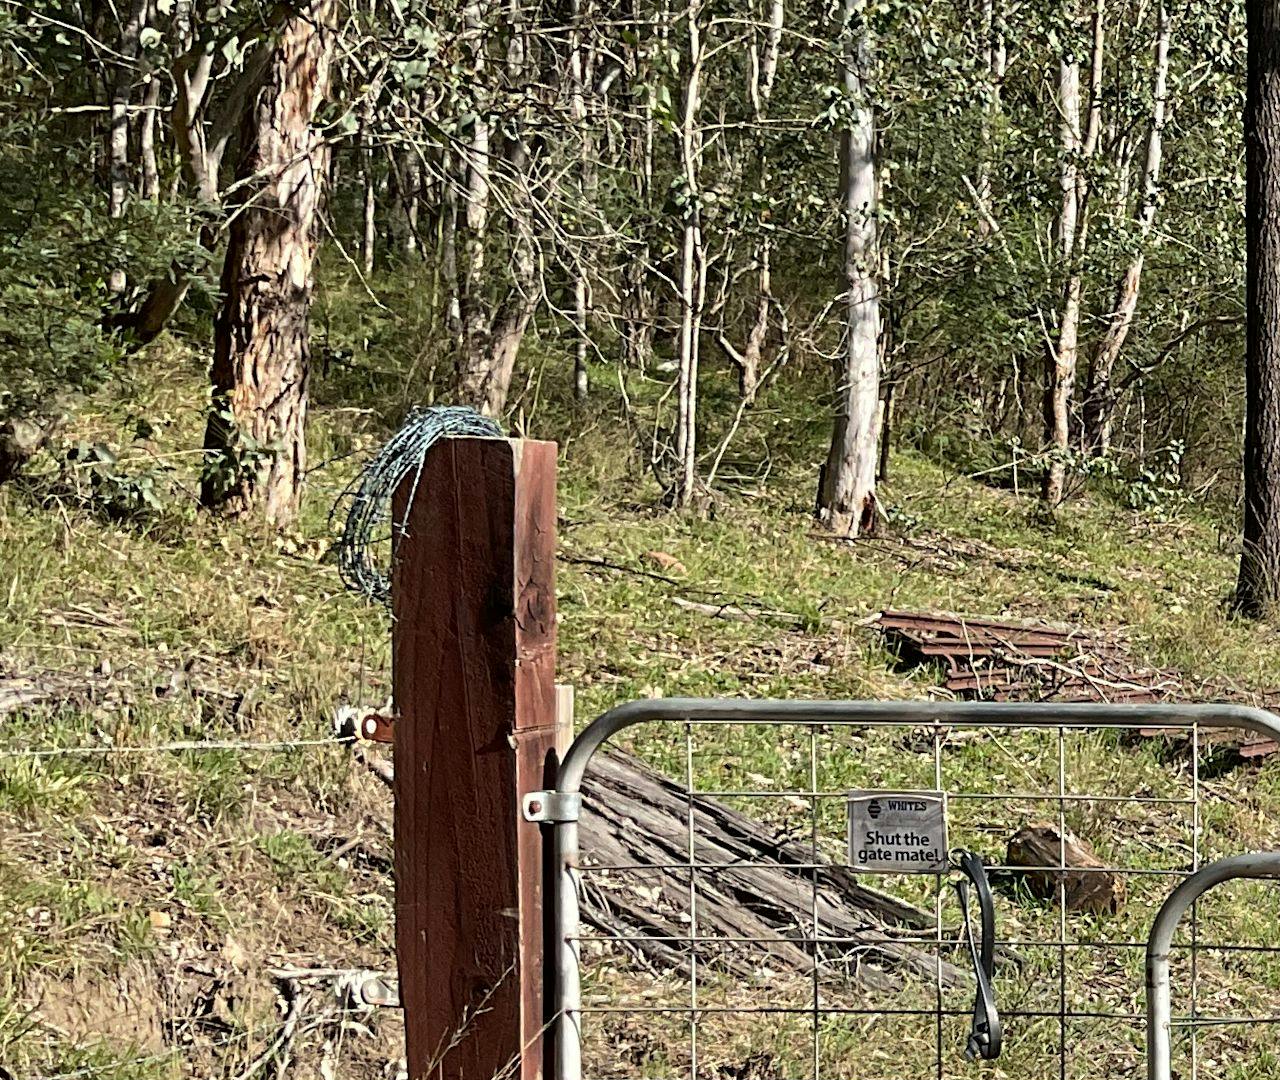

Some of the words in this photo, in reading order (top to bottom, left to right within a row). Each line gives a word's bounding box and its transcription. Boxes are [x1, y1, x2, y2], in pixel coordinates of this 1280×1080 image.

[888, 800, 927, 811] WHITES
[866, 830, 901, 845] Shut
[904, 832, 930, 846] the
[858, 848, 892, 864] gate
[895, 848, 939, 862] mate!
